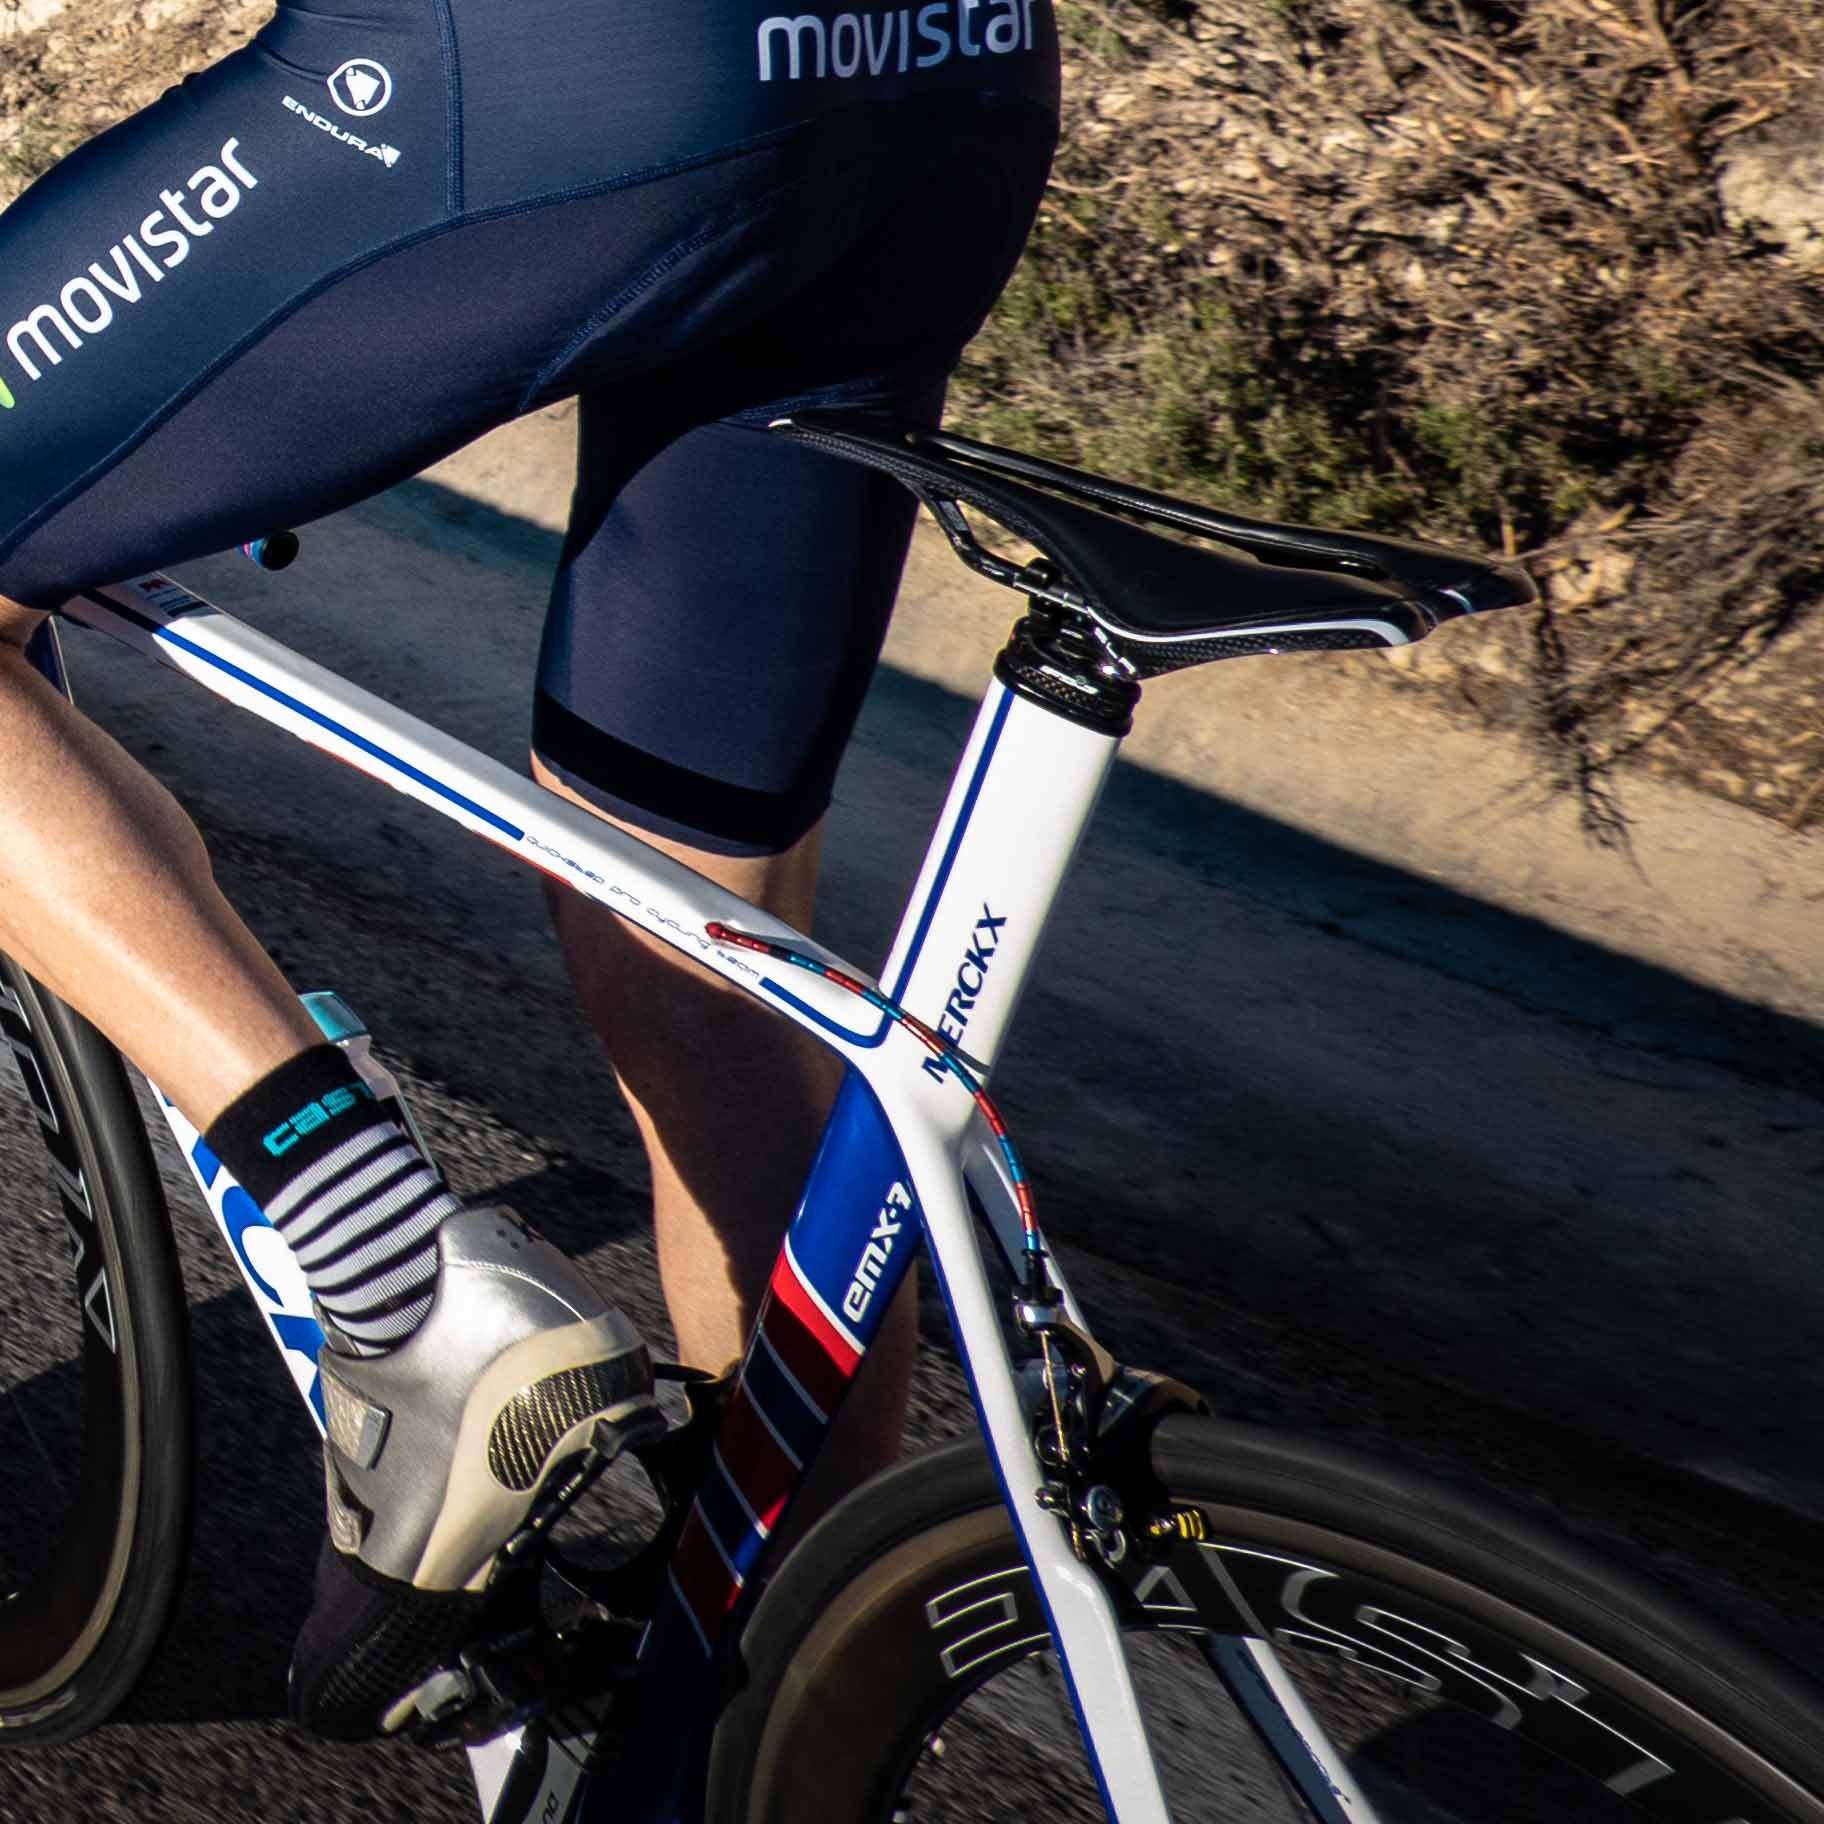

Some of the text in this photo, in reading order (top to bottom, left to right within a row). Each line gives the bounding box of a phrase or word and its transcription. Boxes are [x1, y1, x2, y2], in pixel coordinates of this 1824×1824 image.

[282, 94, 384, 161] ENDURA
[5, 136, 259, 382] movistar
[922, 902, 1008, 1084] MERCKX
